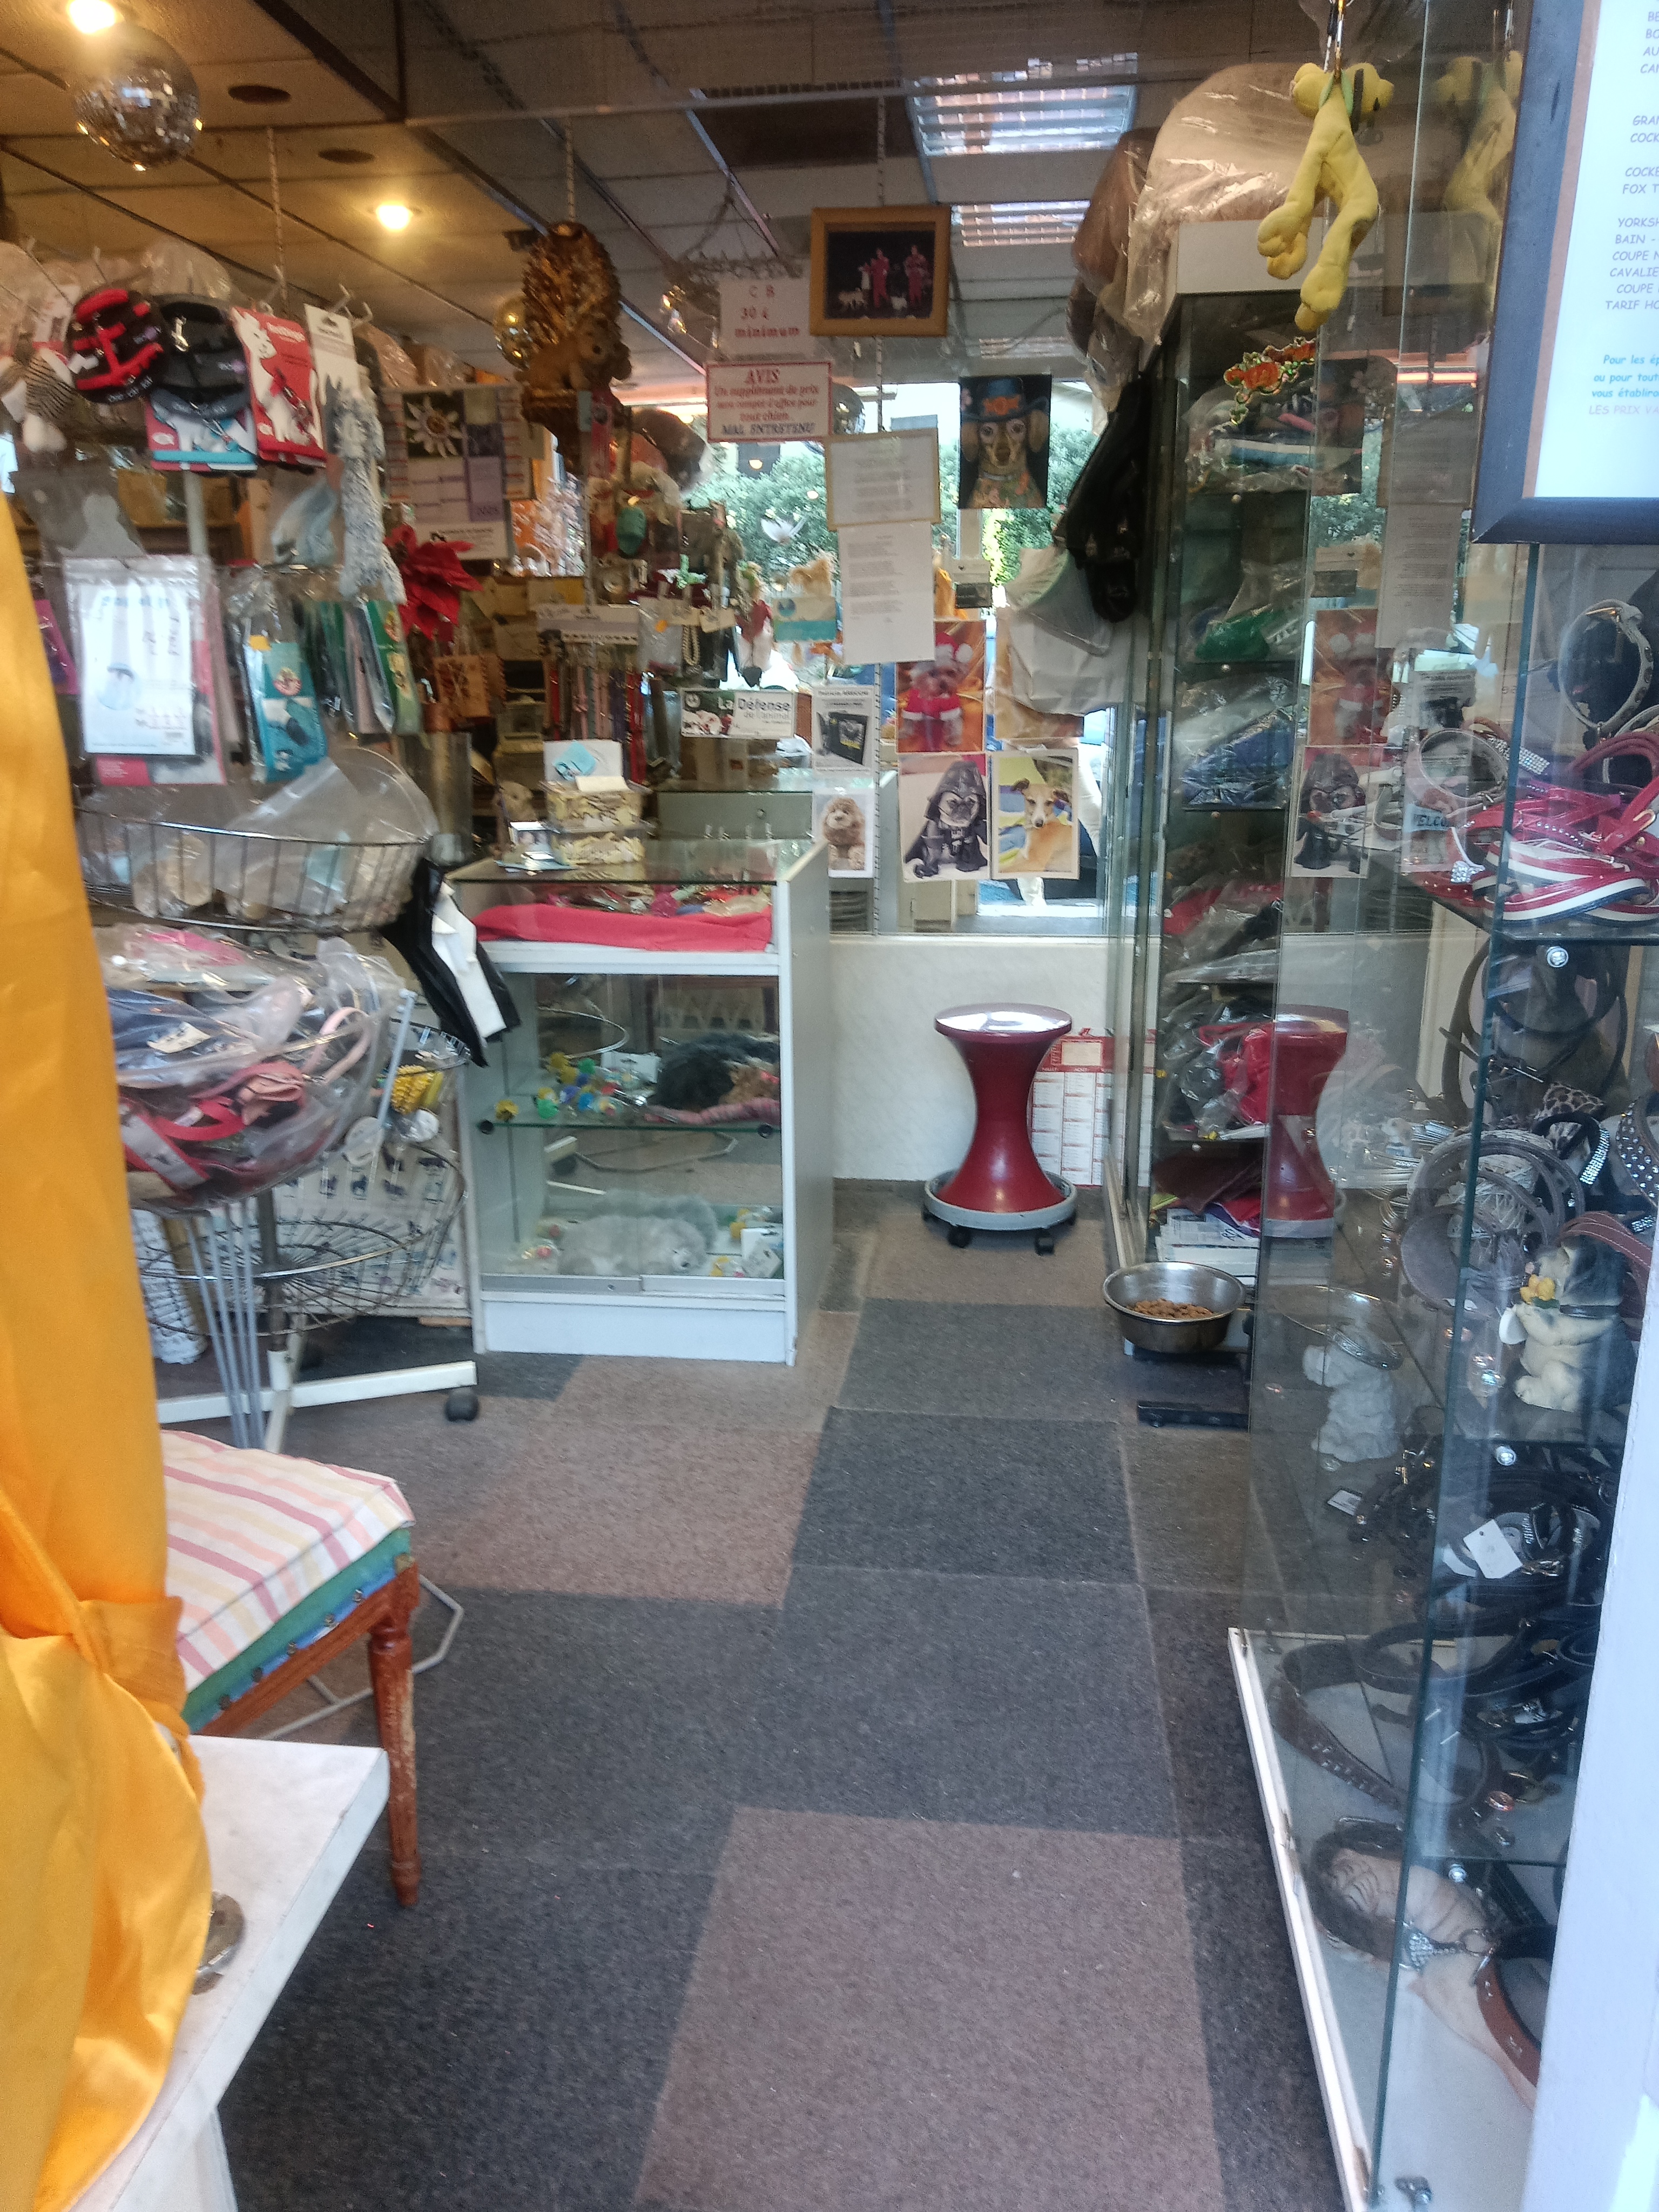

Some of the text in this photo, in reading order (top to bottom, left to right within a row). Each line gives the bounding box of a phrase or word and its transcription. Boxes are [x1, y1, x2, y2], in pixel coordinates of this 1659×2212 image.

[1622, 184, 1647, 194] FOX
[1615, 234, 1645, 244] BAIN
[1612, 250, 1649, 261] COUPE
[1616, 283, 1654, 294] COUPE
[1605, 300, 1640, 310] TARIF
[734, 326, 800, 338] minimum
[1603, 354, 1626, 364] Pour
[1631, 354, 1645, 364] les
[745, 368, 780, 384] AVIS
[1609, 375, 1633, 385] pour
[1589, 405, 1609, 415] LES
[1614, 405, 1640, 415] PRIX
[718, 697, 792, 712] La Défense
